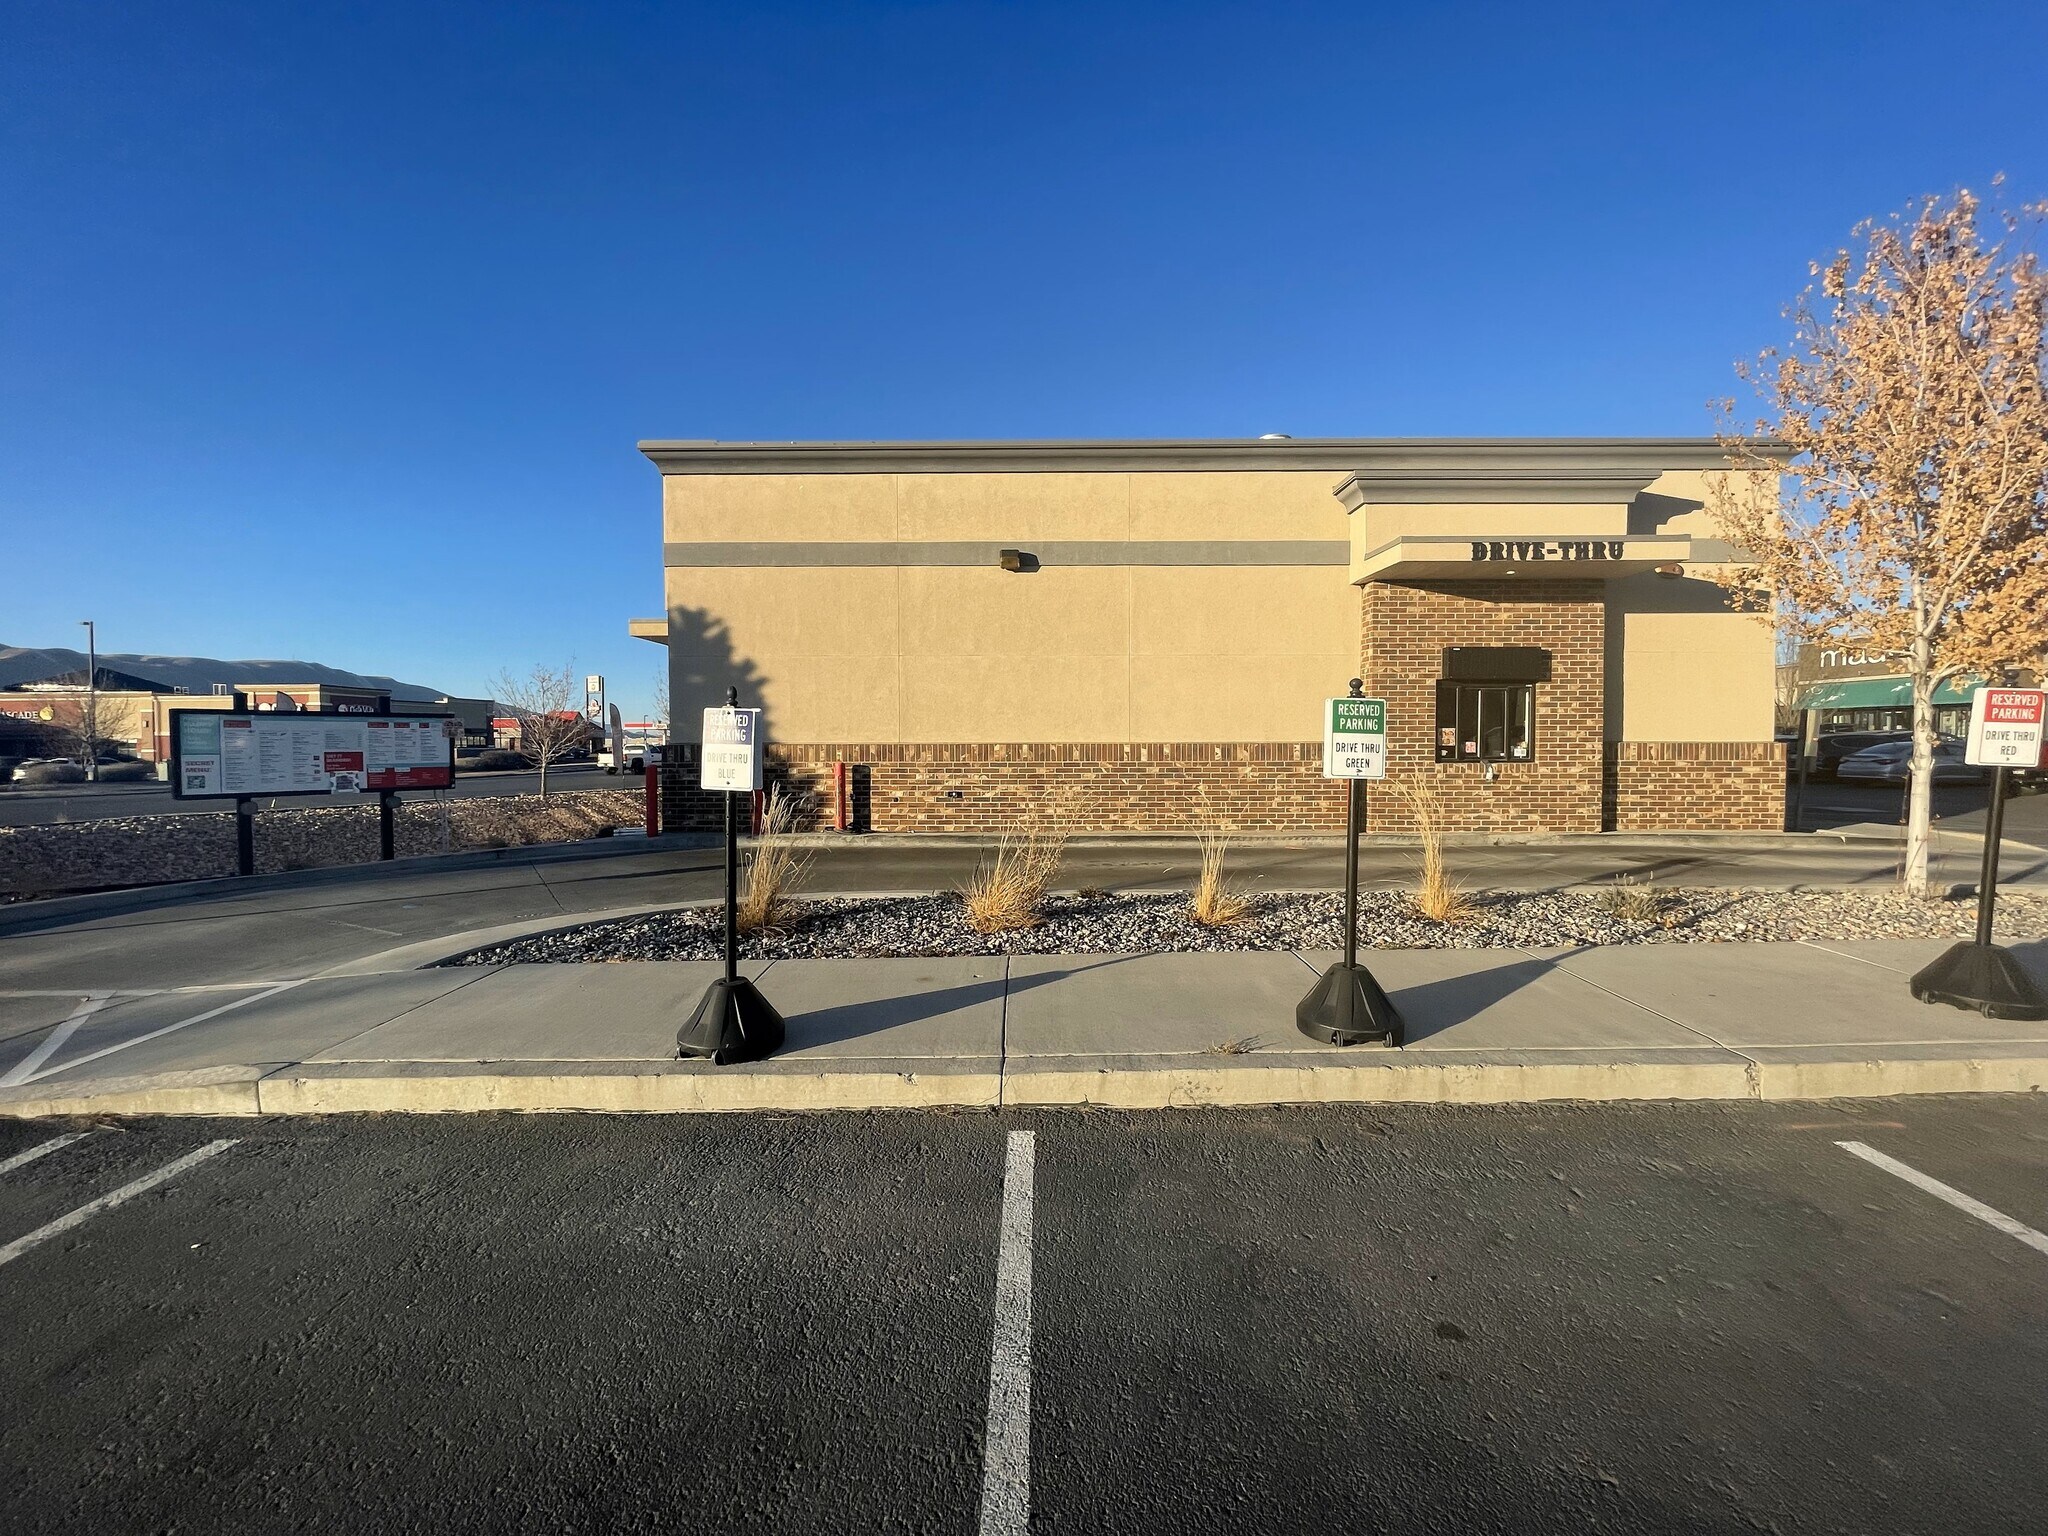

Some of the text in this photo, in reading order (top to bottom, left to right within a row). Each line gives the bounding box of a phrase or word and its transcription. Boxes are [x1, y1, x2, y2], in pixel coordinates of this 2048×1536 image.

[1471, 542, 1624, 561] DRIVE-THRU
[1991, 694, 2039, 706] RESERVED
[1338, 704, 1380, 716] RESERVED
[1991, 708, 2035, 720] PARKING
[1340, 718, 1378, 730] PARKING
[1985, 730, 2035, 741] DRIVE THRU
[1336, 742, 1380, 754] DRIVE THRU
[2000, 746, 2017, 756] RED
[707, 752, 748, 764] DRIVE THRU
[1346, 758, 1370, 768] GREEN
[718, 769, 735, 779] BLUE
